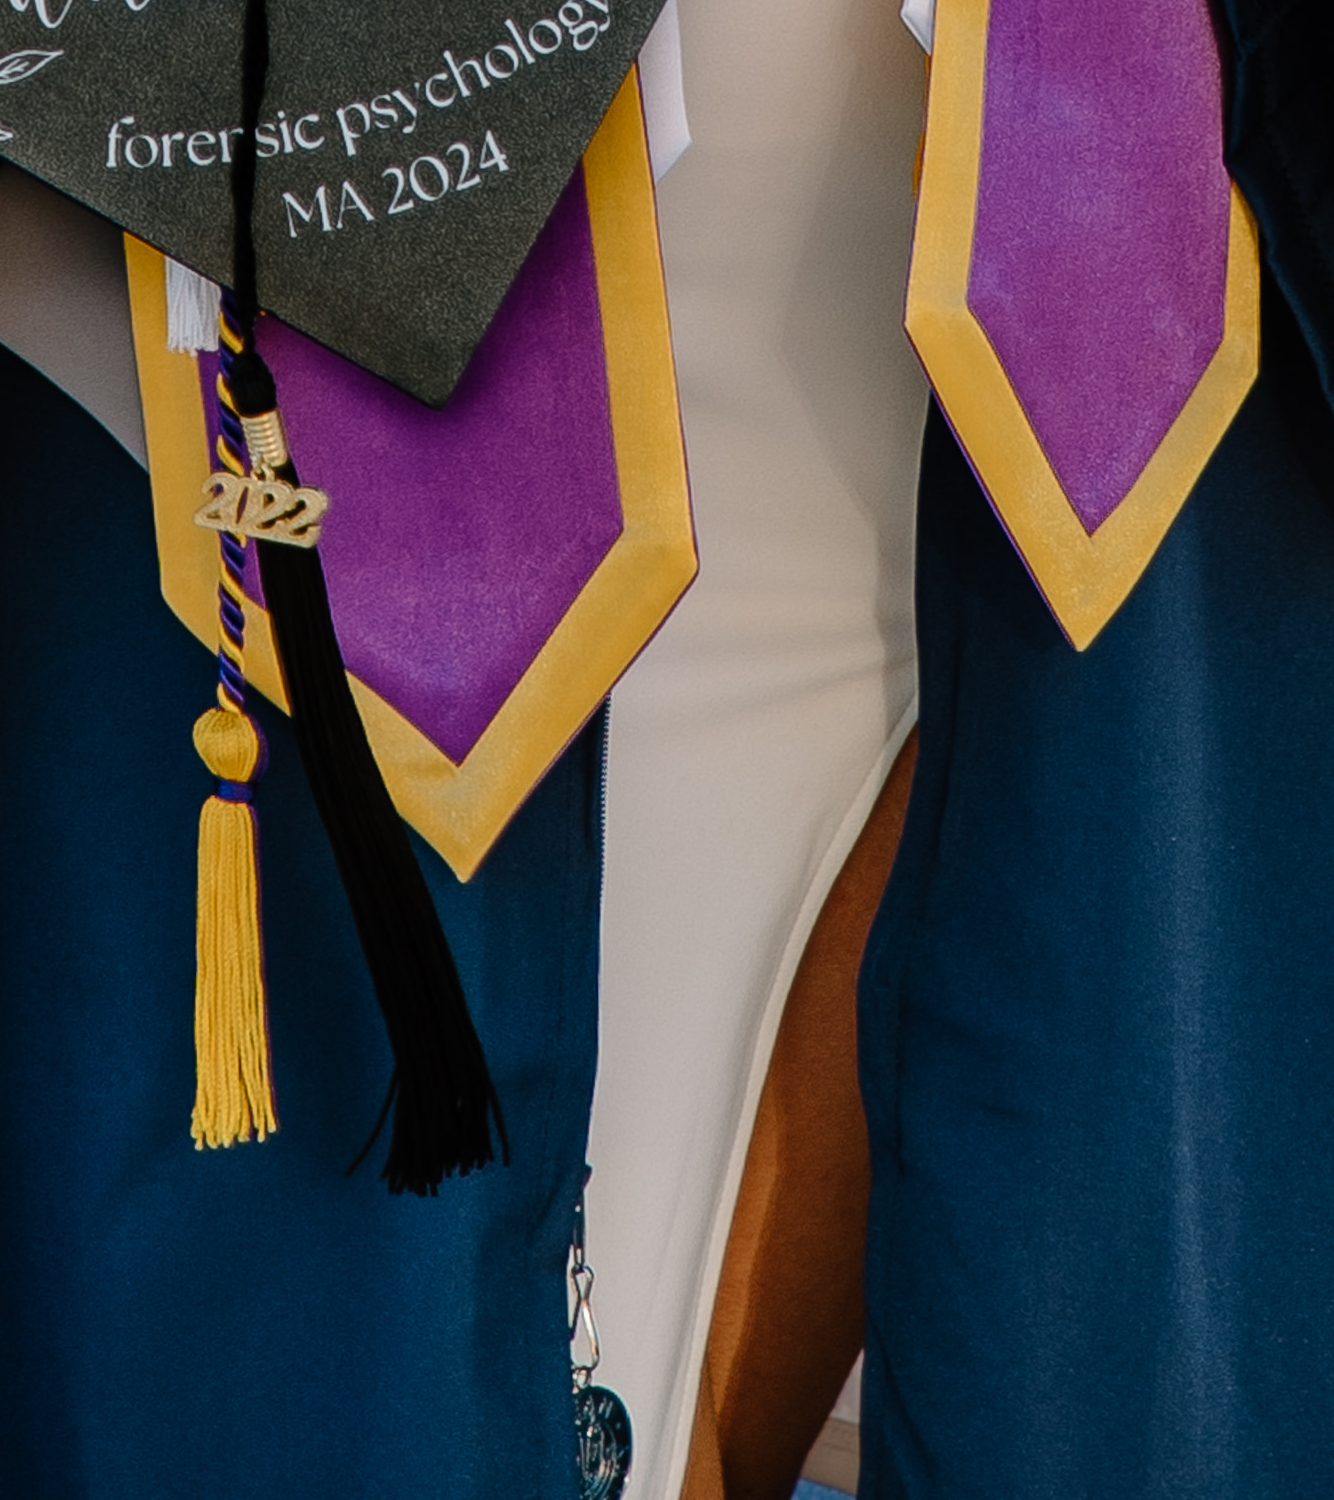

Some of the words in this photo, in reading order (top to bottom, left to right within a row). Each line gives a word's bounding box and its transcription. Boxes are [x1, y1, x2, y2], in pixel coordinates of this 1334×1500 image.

[282, 180, 375, 238] MA
[380, 129, 511, 216] 2024
[193, 471, 330, 549] 2022
